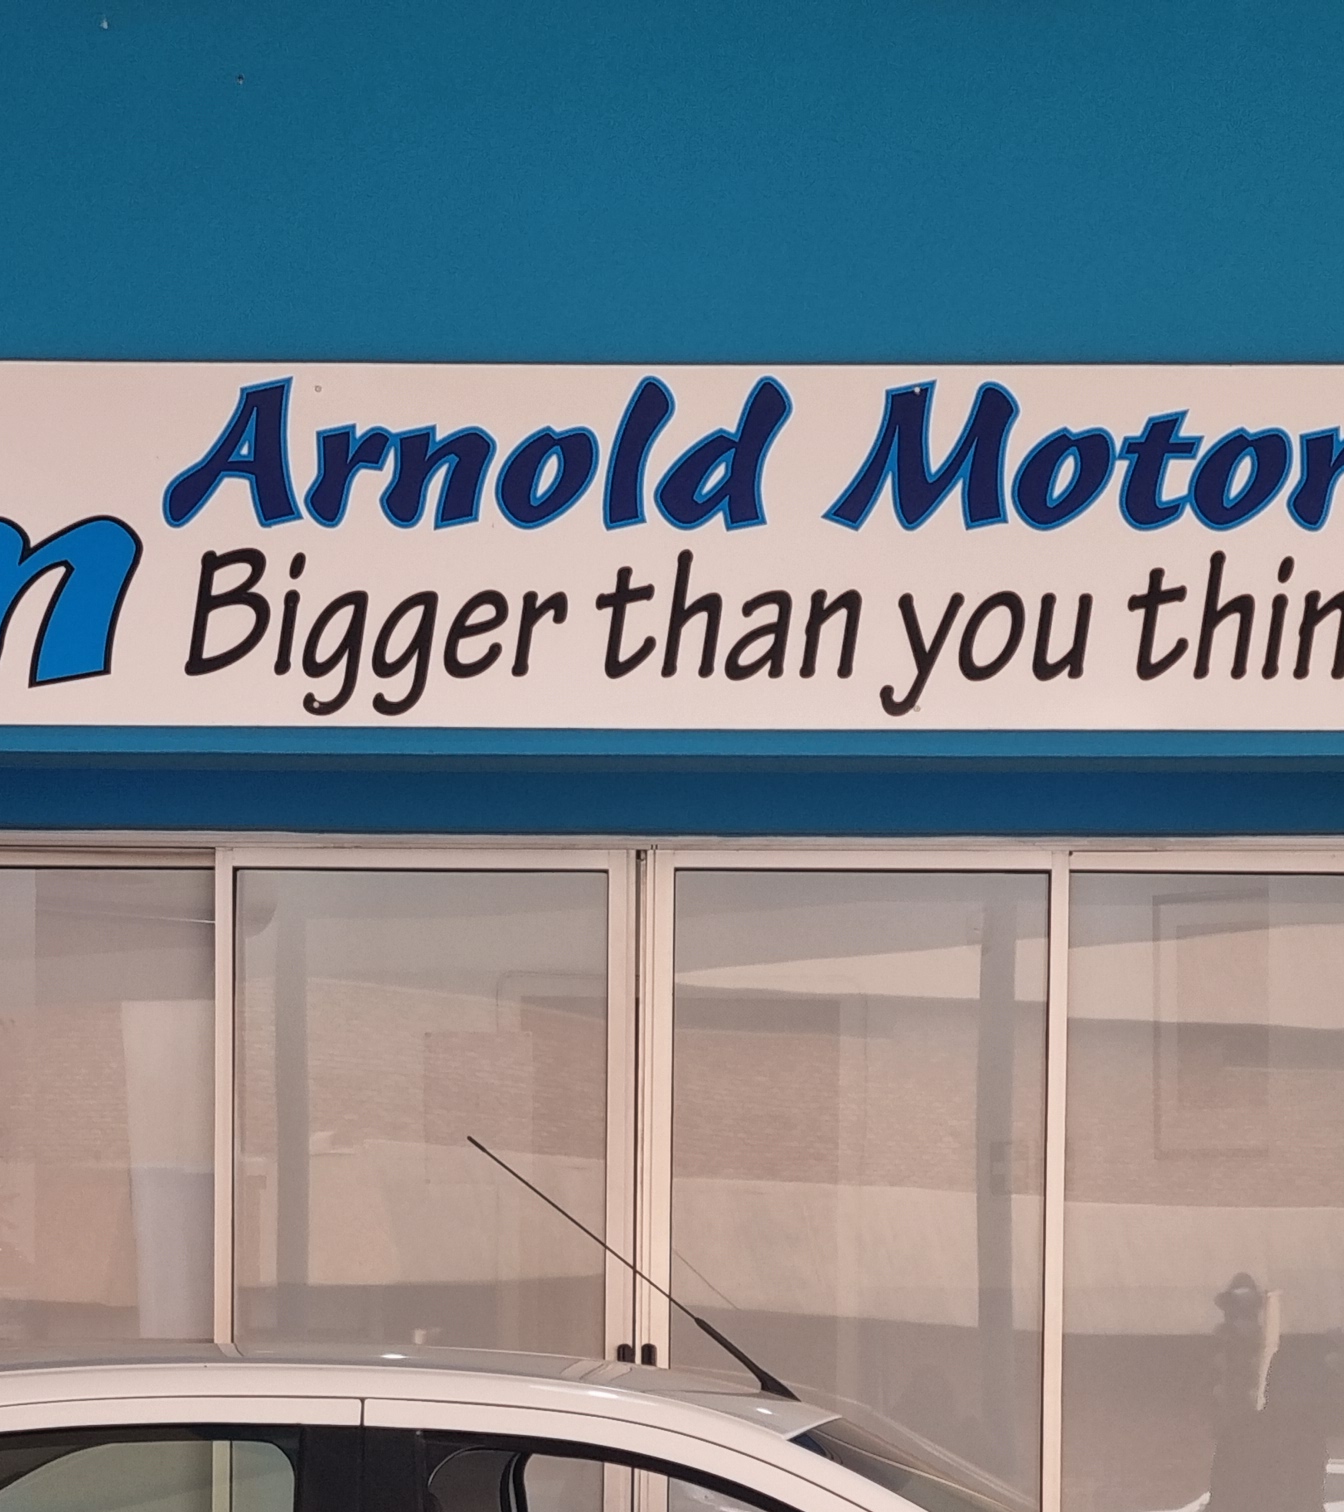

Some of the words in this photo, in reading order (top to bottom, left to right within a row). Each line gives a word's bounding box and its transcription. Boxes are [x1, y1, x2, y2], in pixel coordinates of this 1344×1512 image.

[163, 376, 792, 531] Arnold
[185, 548, 568, 716] Bigger
[596, 549, 862, 681] than
[880, 591, 1093, 716] you
